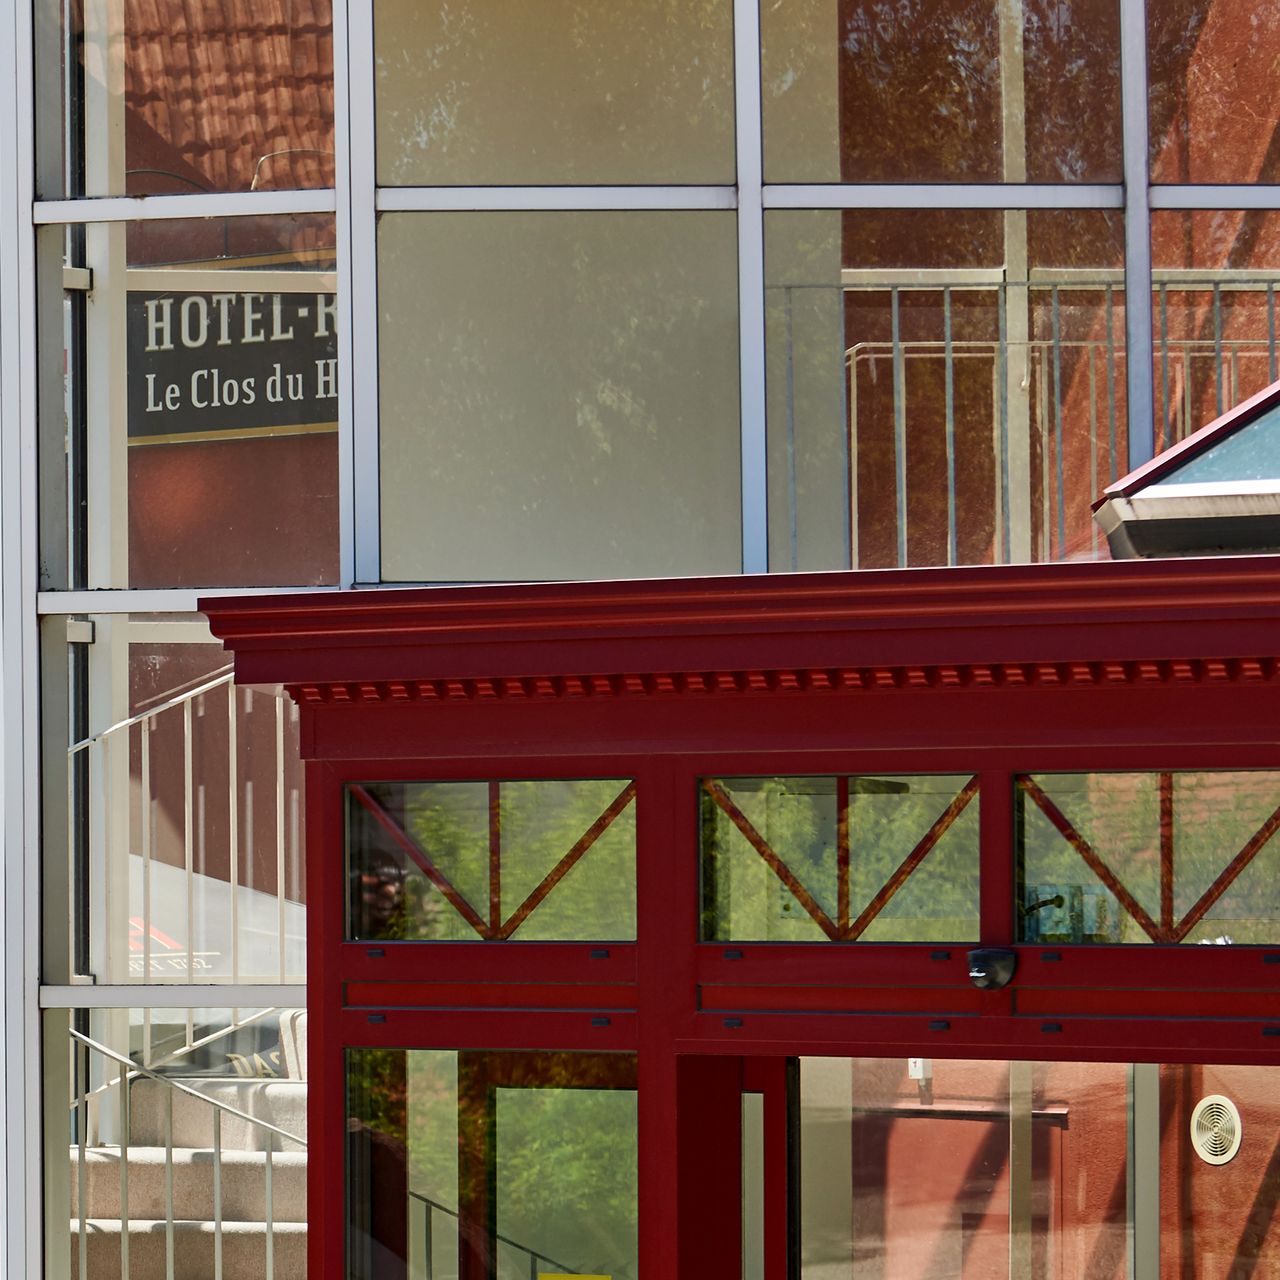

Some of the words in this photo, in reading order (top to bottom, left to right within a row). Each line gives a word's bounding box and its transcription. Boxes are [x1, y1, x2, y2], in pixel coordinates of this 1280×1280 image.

[145, 373, 180, 413] Le
[191, 368, 256, 408] Clos
[266, 363, 304, 402] du
